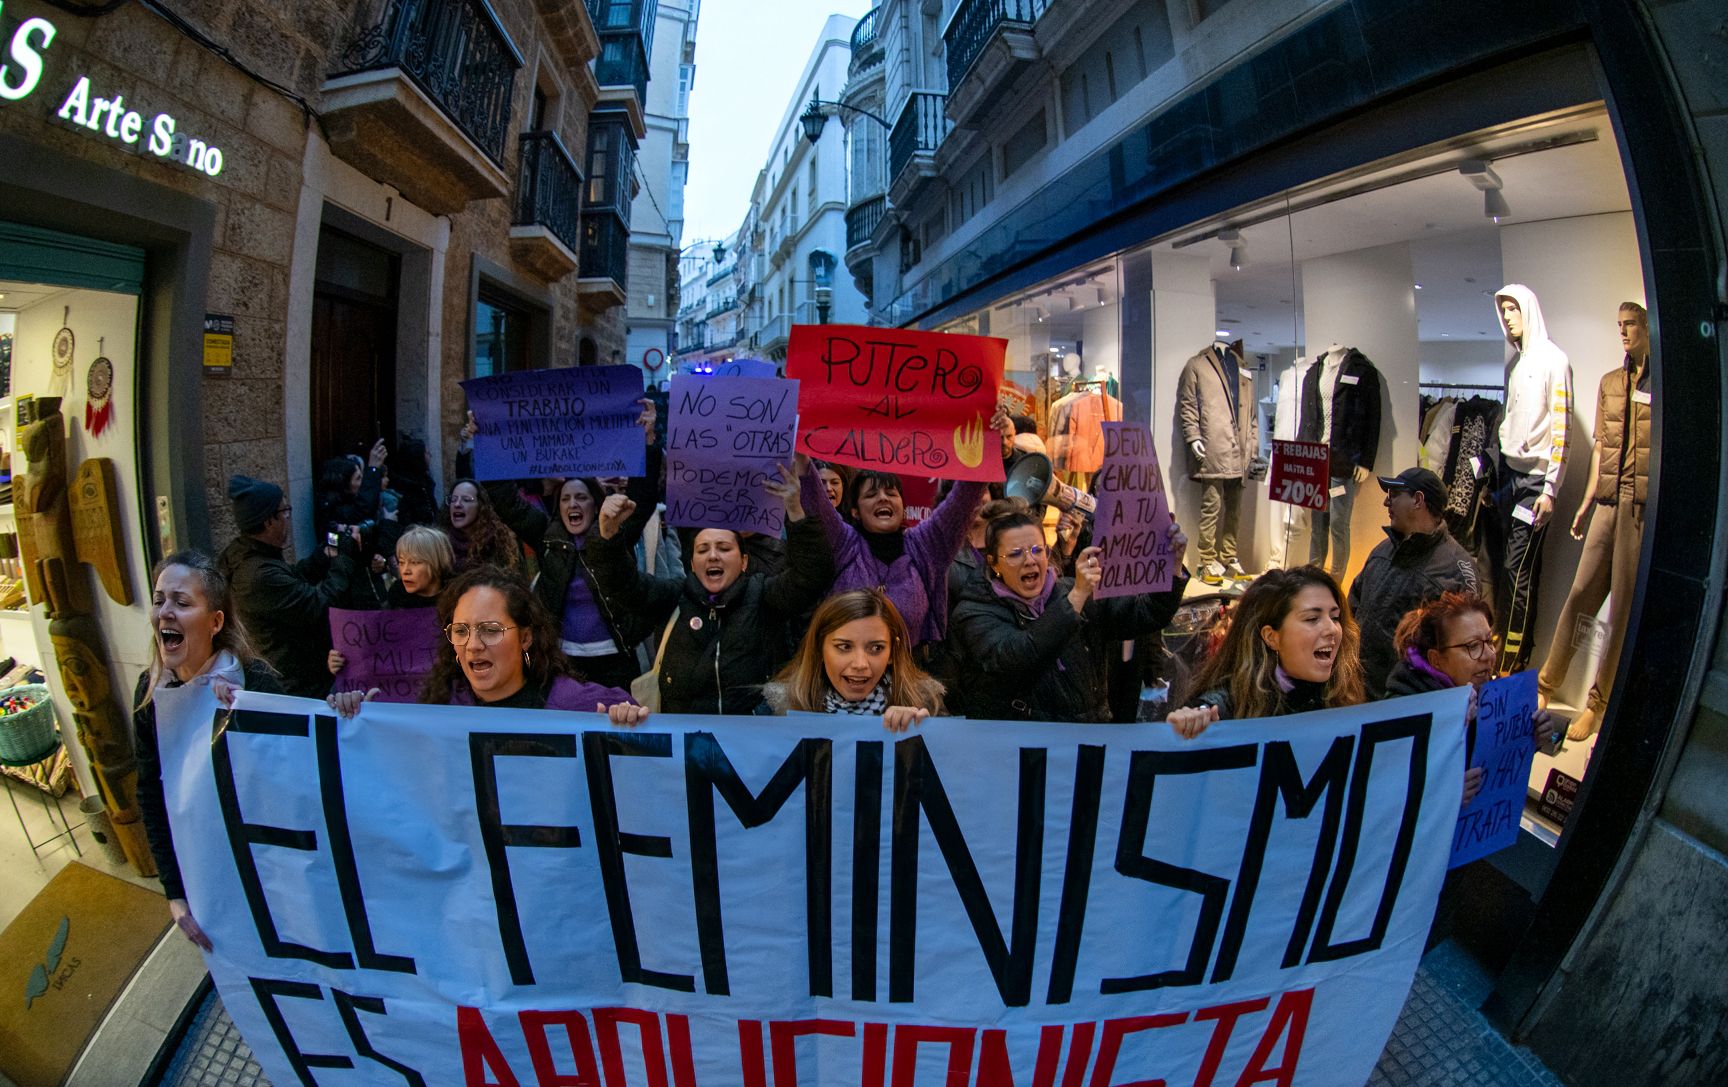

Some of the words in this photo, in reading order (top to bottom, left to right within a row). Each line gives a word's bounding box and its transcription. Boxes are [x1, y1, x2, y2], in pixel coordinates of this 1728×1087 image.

[475, 382, 577, 400] CONSIDERAR
[588, 380, 611, 395] UN
[679, 384, 717, 418] NO
[726, 388, 789, 424] SON
[502, 399, 586, 418] TRABAJO
[857, 394, 918, 419] AL
[500, 436, 524, 451] UNA
[532, 432, 575, 450] MAMADA
[582, 432, 595, 447] O
[670, 428, 718, 451] LAS
[1104, 427, 1149, 458] DEJA
[1283, 443, 1328, 461] REBAJAS
[512, 450, 528, 464] UN
[1283, 463, 1305, 475] HASTA
[1306, 467, 1315, 476] EL
[695, 486, 756, 505] SER
[1275, 479, 1324, 508] -70%
[670, 499, 783, 532] NOSOTRAS
[1111, 499, 1124, 527] A
[1137, 497, 1158, 524] TU
[342, 620, 400, 649] QUE
[1490, 746, 1529, 792] HAY
[1457, 800, 1512, 852] TRATA
[212, 708, 417, 974] EL
[469, 712, 1433, 1007] FEMINISMO
